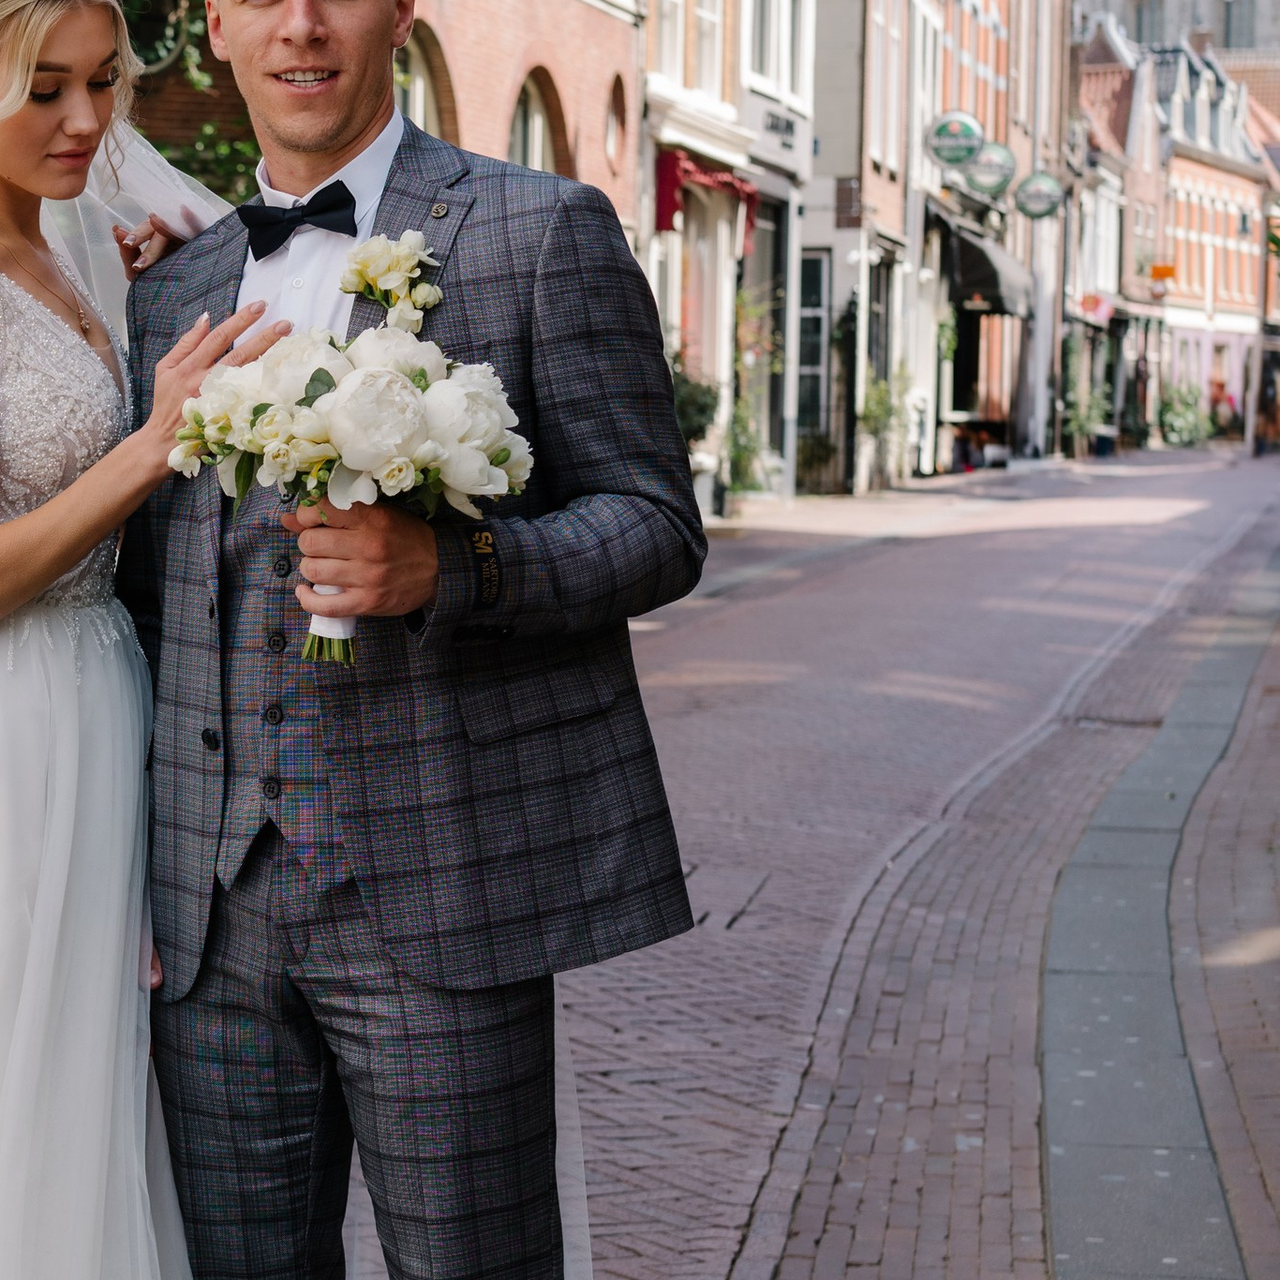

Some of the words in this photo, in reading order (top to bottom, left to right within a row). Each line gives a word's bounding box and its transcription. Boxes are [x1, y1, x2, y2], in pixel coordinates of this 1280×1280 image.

[472, 531, 494, 554] SM
[481, 562, 490, 602] MILANO
[487, 557, 499, 603] SARTORIA
